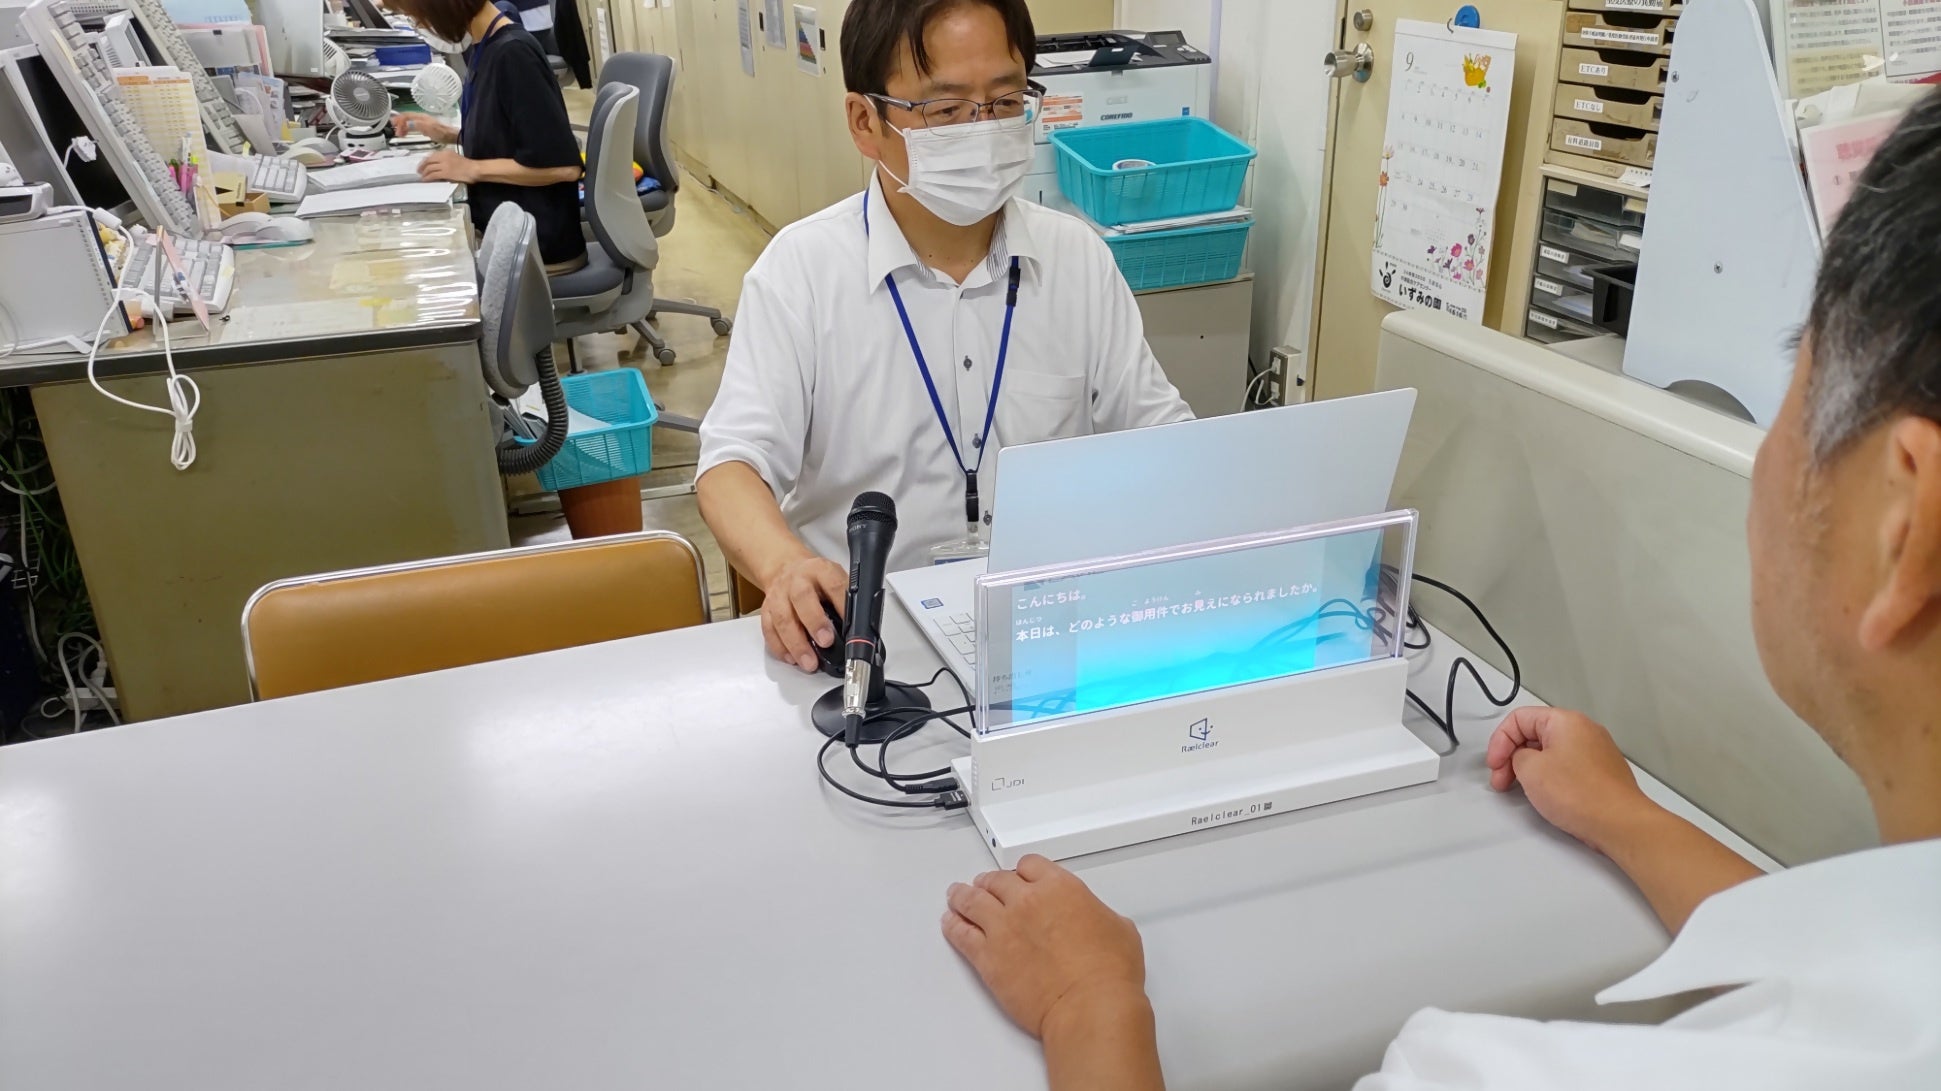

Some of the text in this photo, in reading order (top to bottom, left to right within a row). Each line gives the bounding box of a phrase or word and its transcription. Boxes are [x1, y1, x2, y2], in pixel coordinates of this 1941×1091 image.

[1404, 51, 1415, 72] 9
[1100, 112, 1133, 121] COREFIDO
[1398, 283, 1442, 310] いずみの園
[1016, 589, 1086, 610] こんにちは。
[1015, 583, 1318, 643] 本日は、どのような御用件でお見えになられましたか。
